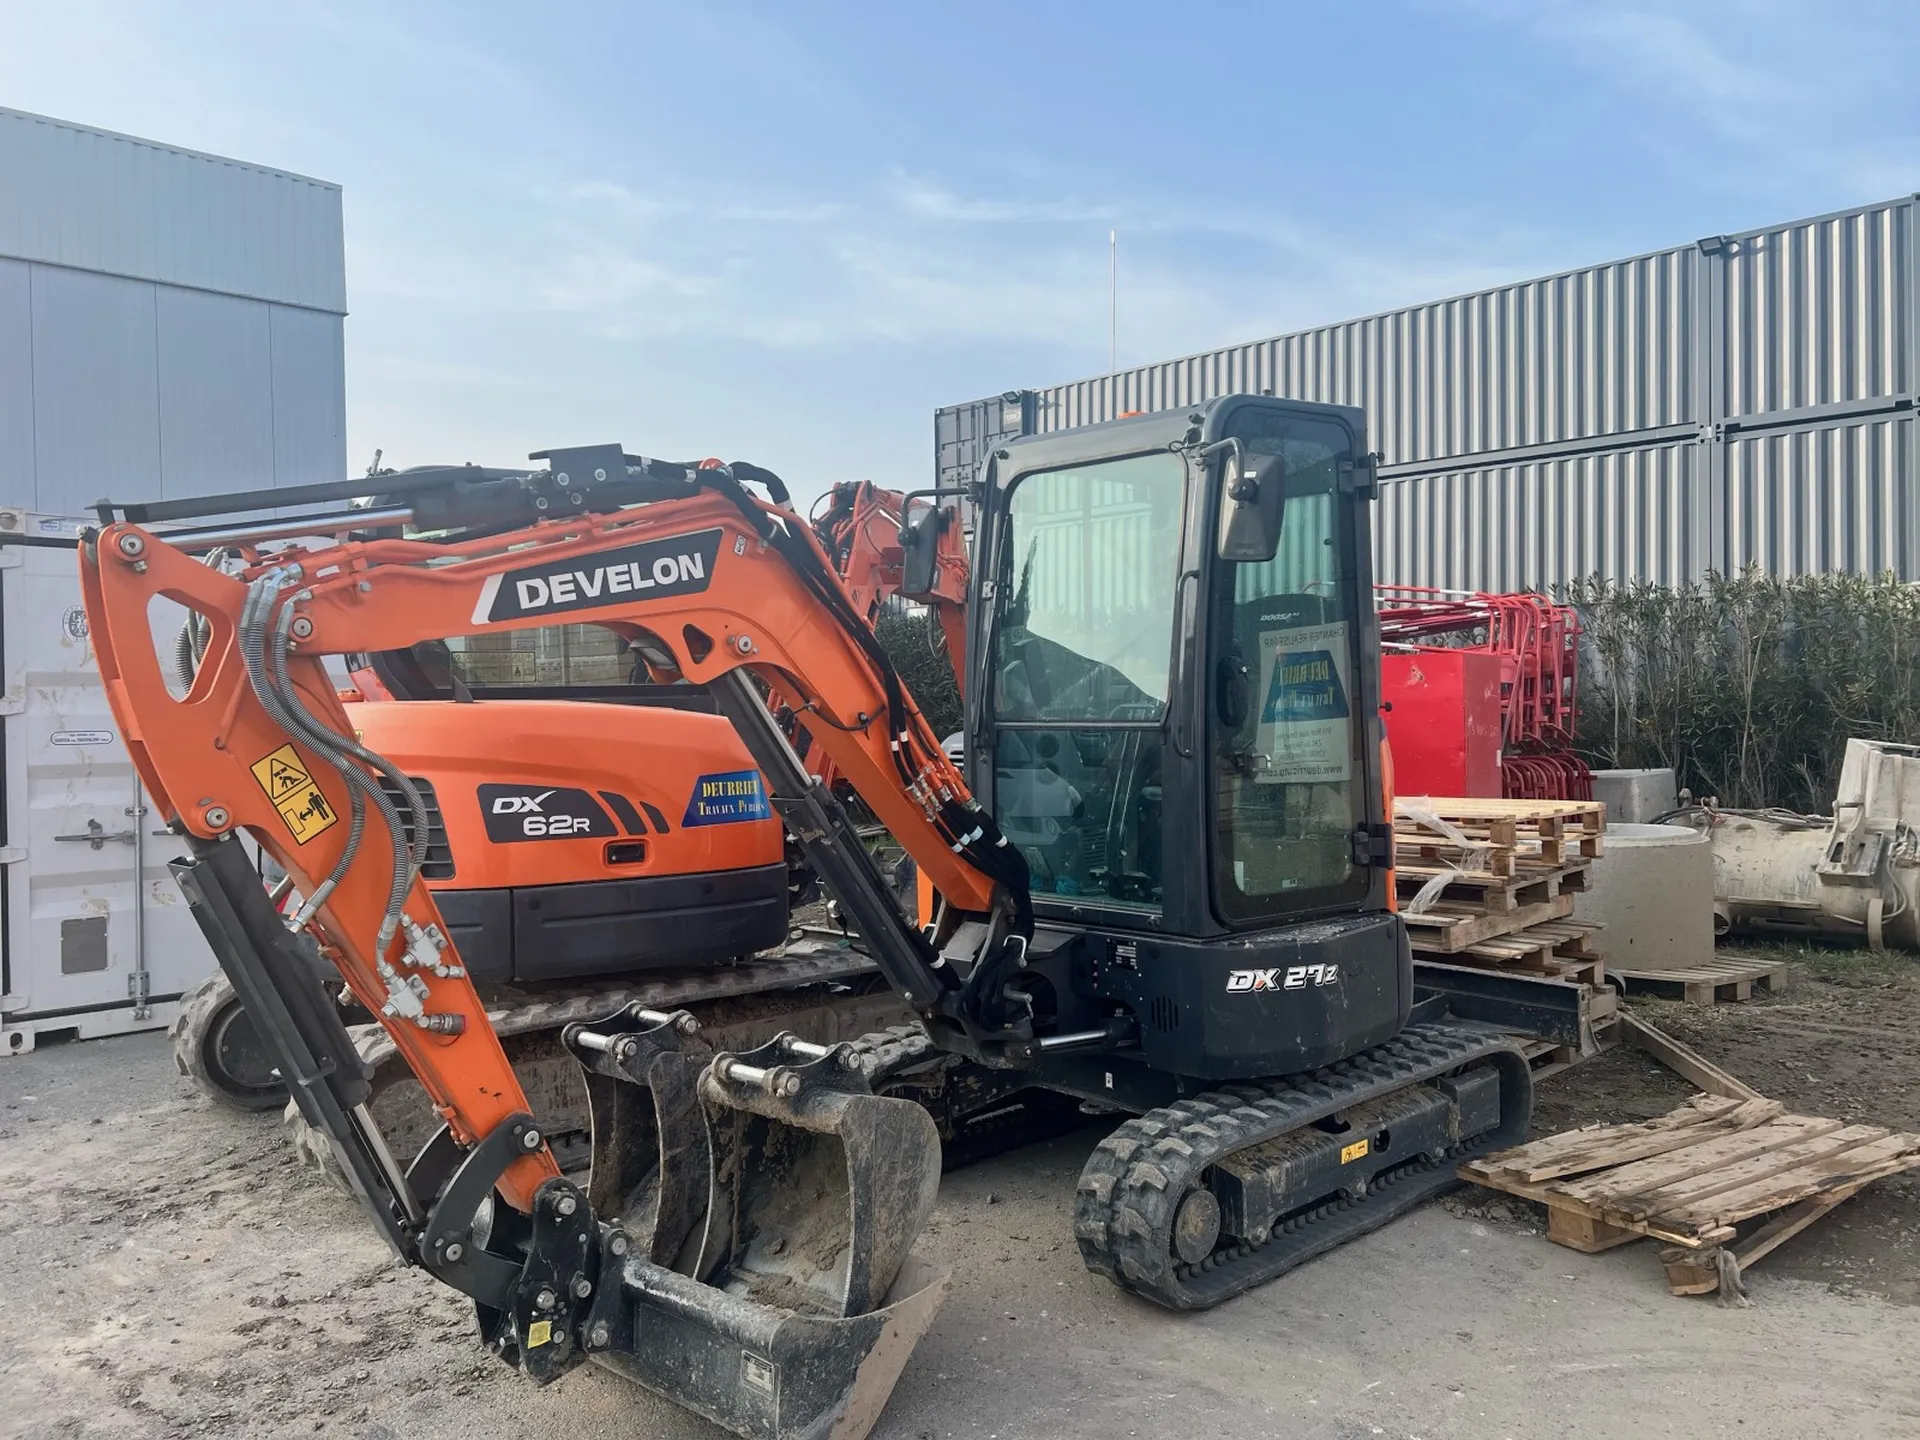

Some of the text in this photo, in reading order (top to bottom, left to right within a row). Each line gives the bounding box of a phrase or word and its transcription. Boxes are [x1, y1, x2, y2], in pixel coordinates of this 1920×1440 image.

[516, 552, 705, 610] DEVELON
[702, 780, 758, 798] DEURRIEU
[492, 790, 557, 815] DX
[523, 814, 591, 836] 62R
[1226, 967, 1281, 993] DX
